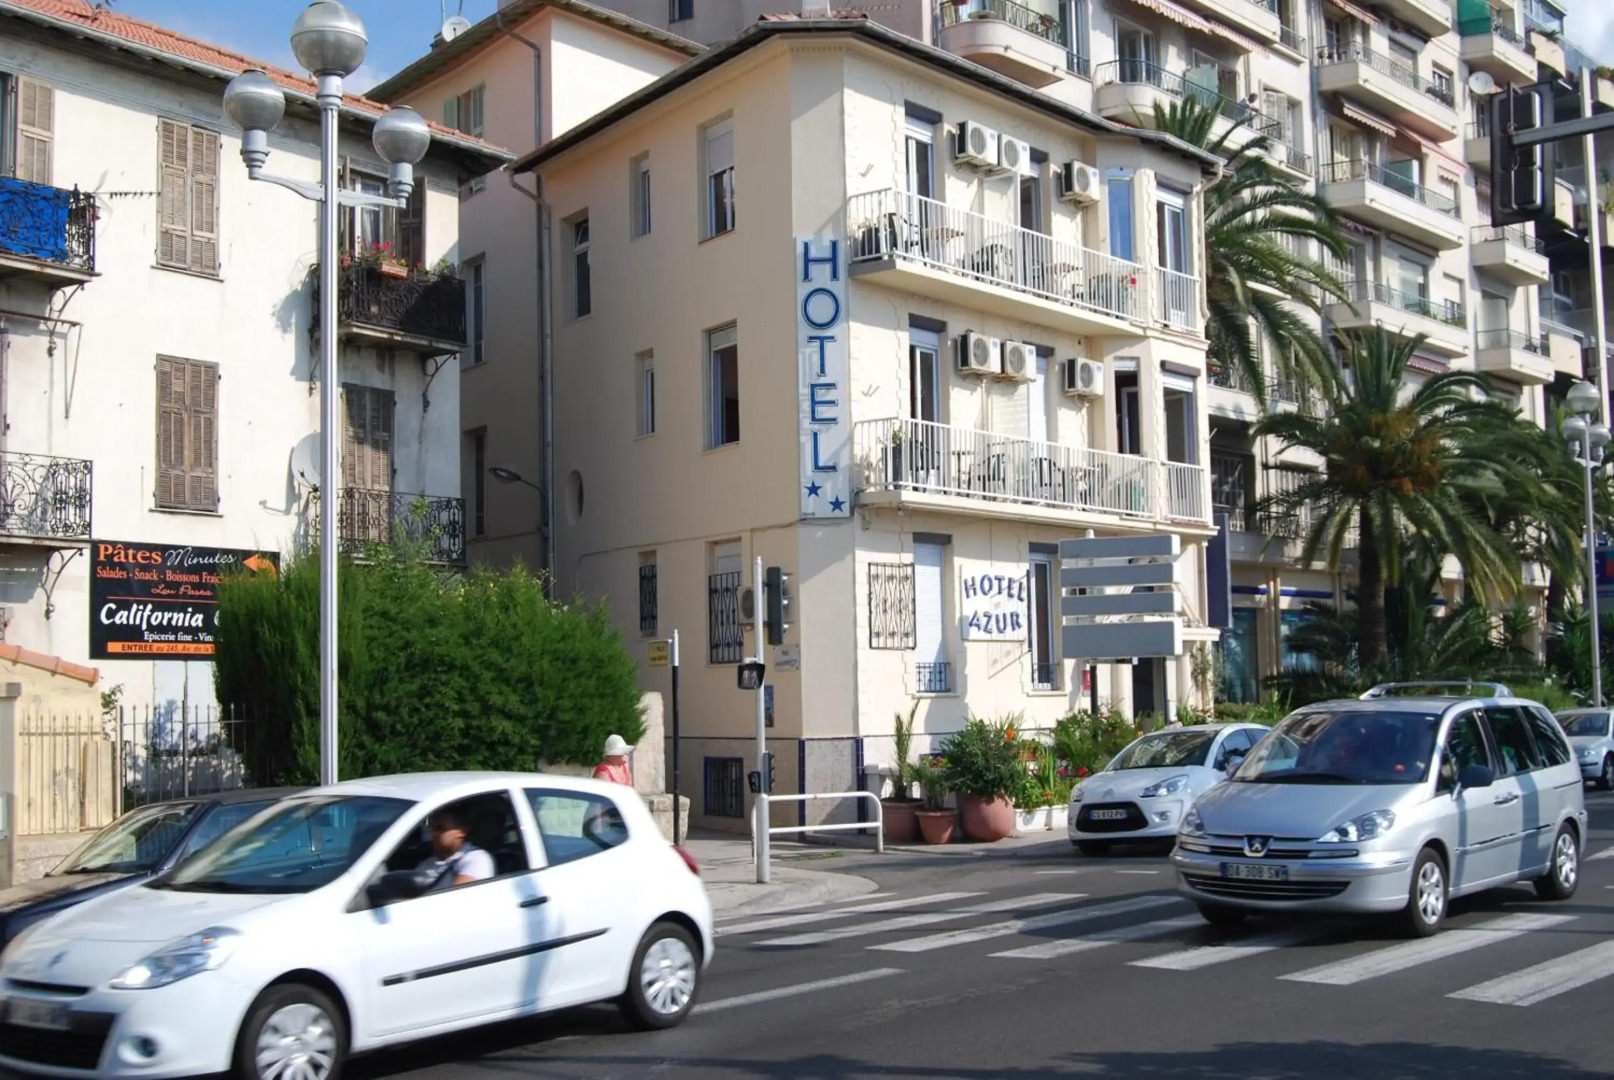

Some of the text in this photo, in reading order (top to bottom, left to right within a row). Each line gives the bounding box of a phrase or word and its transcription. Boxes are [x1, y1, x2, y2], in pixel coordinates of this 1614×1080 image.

[802, 239, 840, 473] HOTEL
[97, 543, 237, 567] Pâtes Minutes
[96, 566, 128, 579] Salades
[134, 568, 159, 581] Snack
[166, 569, 200, 583] Boissons
[963, 574, 1025, 603] HOTEL
[100, 602, 204, 631] California
[967, 610, 1023, 634] AZUR
[144, 630, 176, 642] Epicerie
[178, 631, 193, 642] fine
